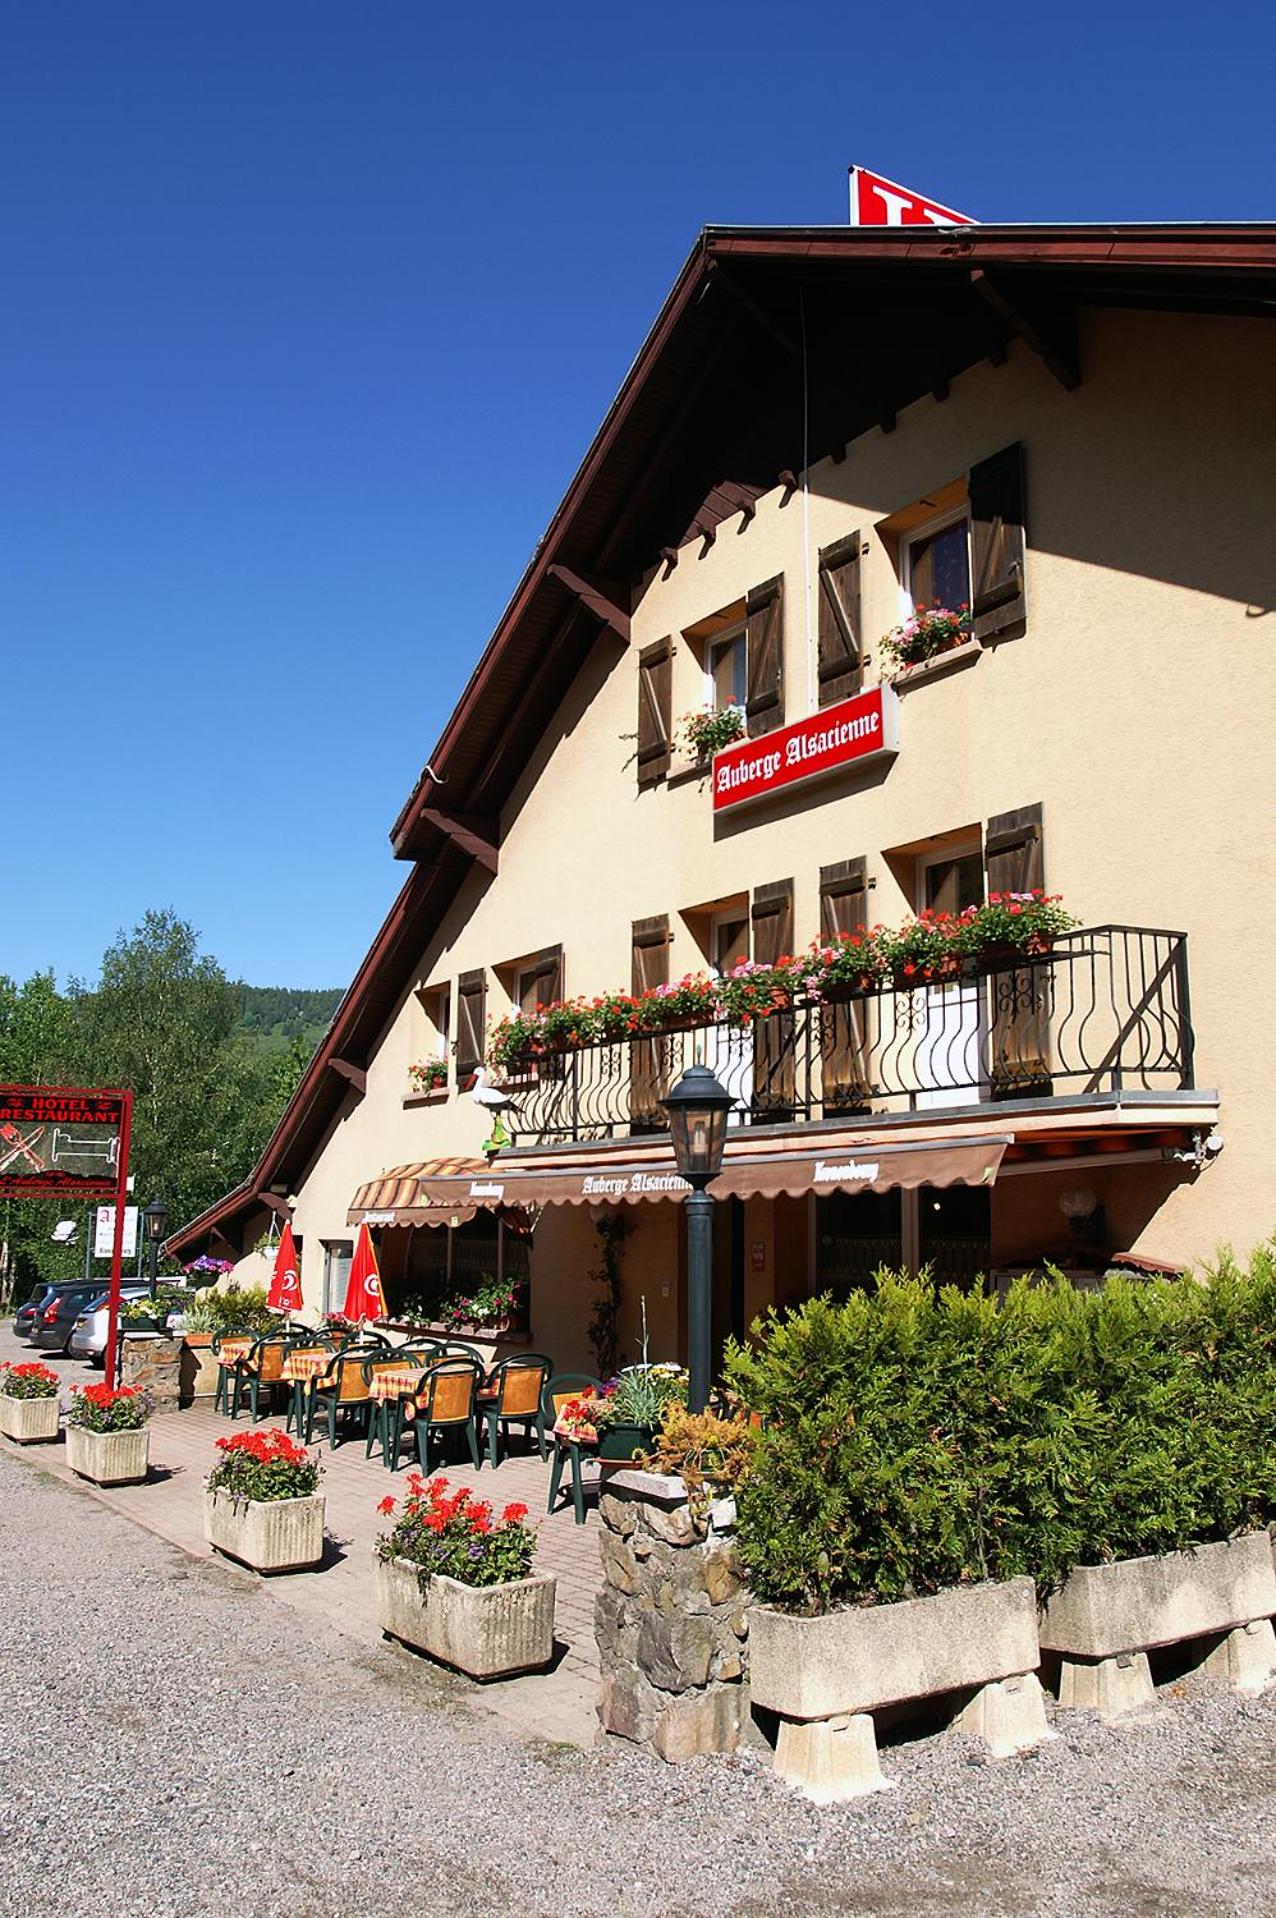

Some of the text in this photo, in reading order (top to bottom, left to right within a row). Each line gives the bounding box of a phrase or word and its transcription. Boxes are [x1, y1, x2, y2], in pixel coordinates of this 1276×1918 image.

[717, 711, 880, 792] Auberge Alsacienne
[0, 1108, 119, 1122] RESTAURANT
[582, 1175, 629, 1196] Auberge
